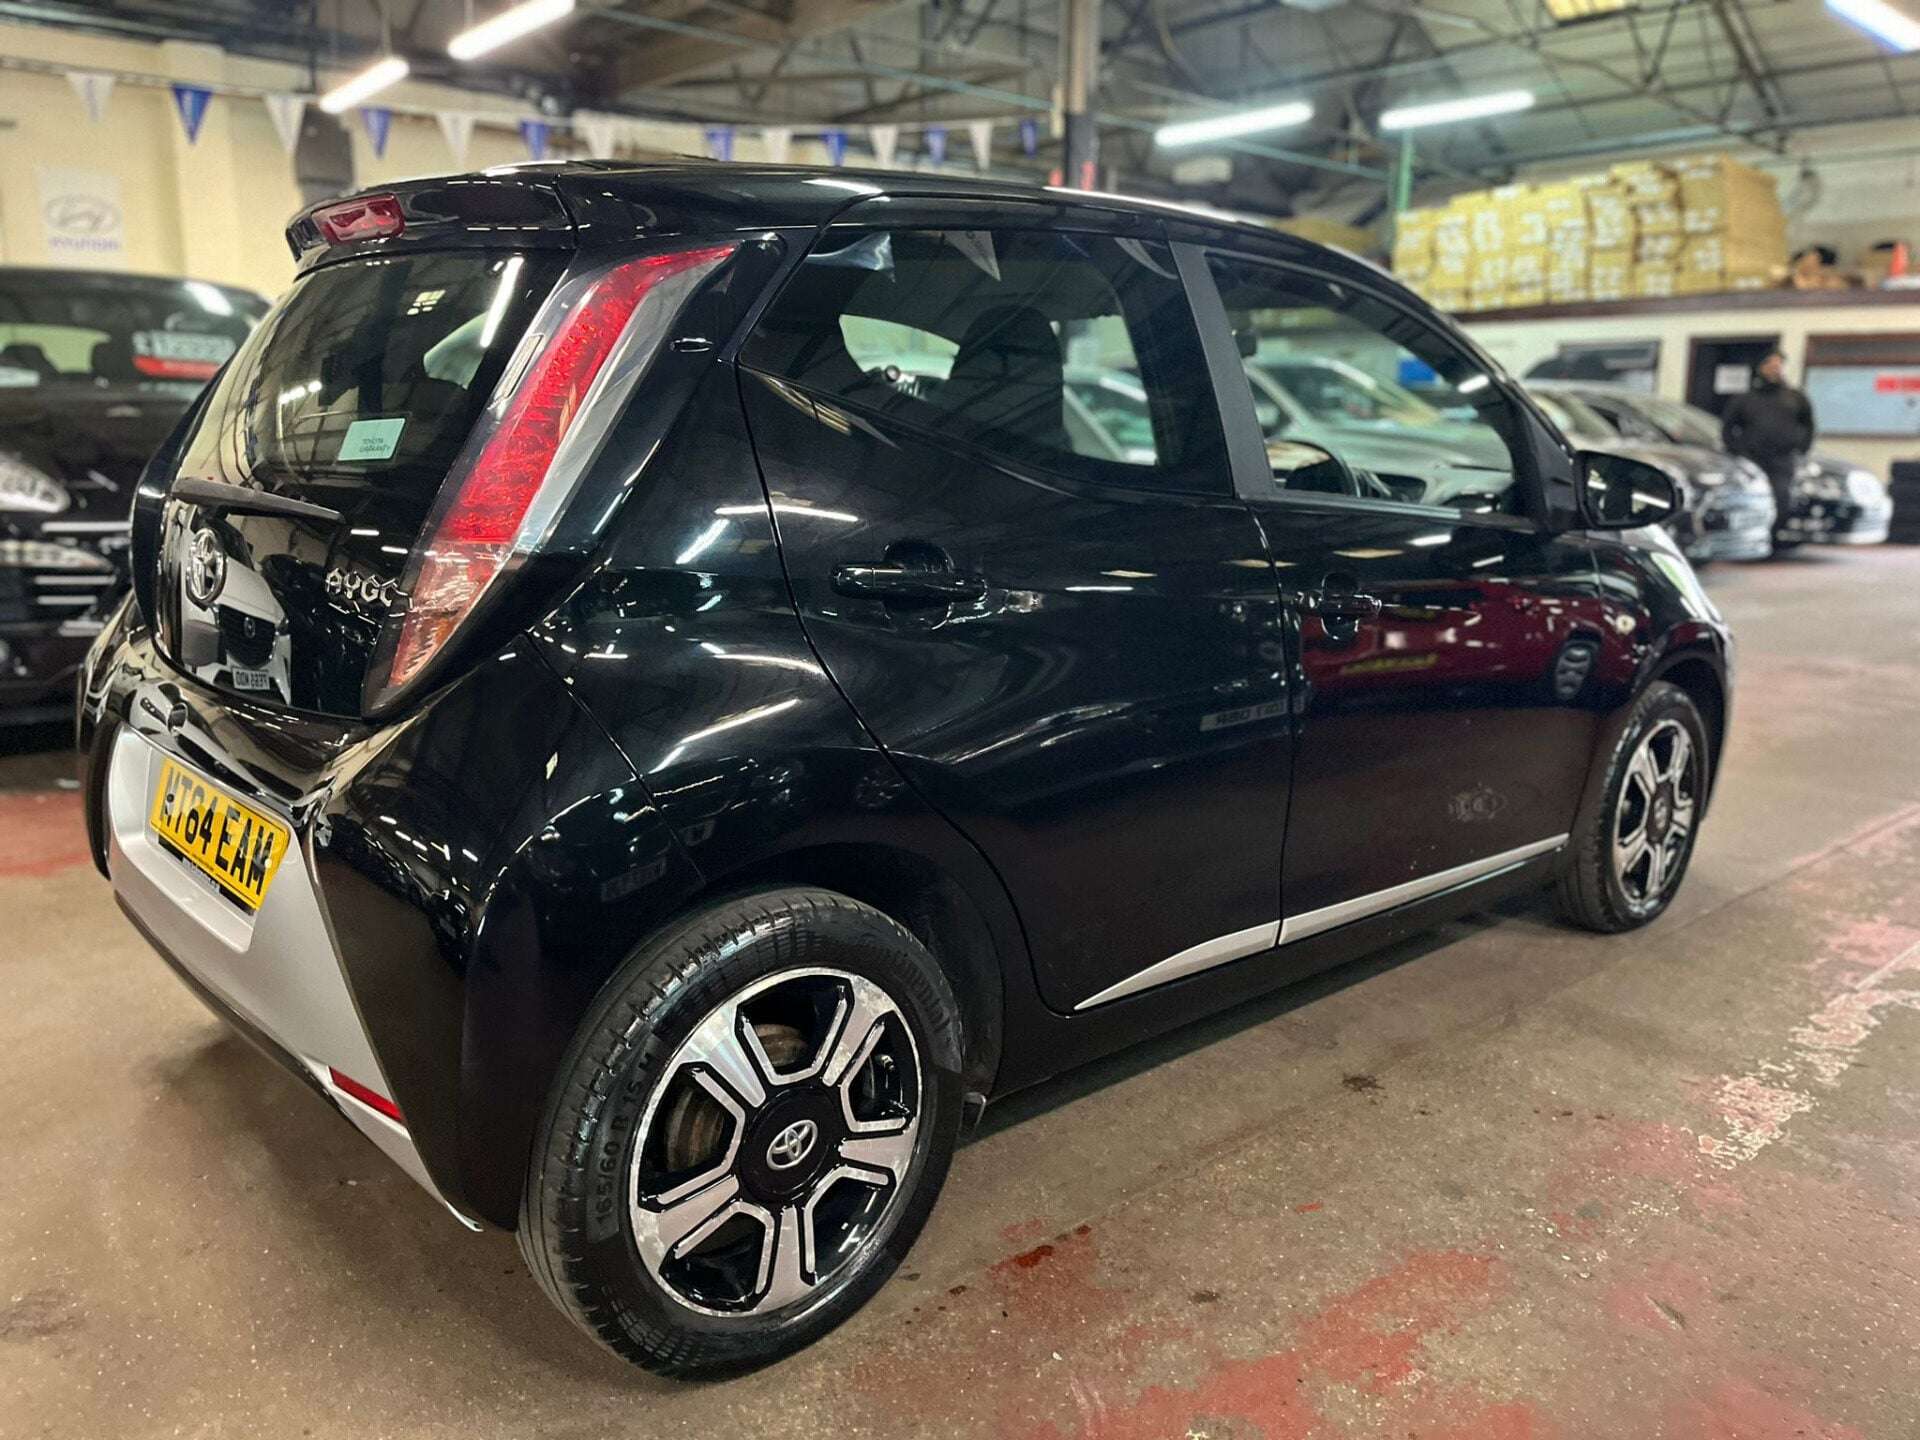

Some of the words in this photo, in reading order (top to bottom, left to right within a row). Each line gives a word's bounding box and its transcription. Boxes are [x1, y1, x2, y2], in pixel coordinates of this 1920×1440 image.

[215, 806, 274, 895] EAM
[595, 1140, 621, 1224] 165/60
[624, 1081, 643, 1103] 15
